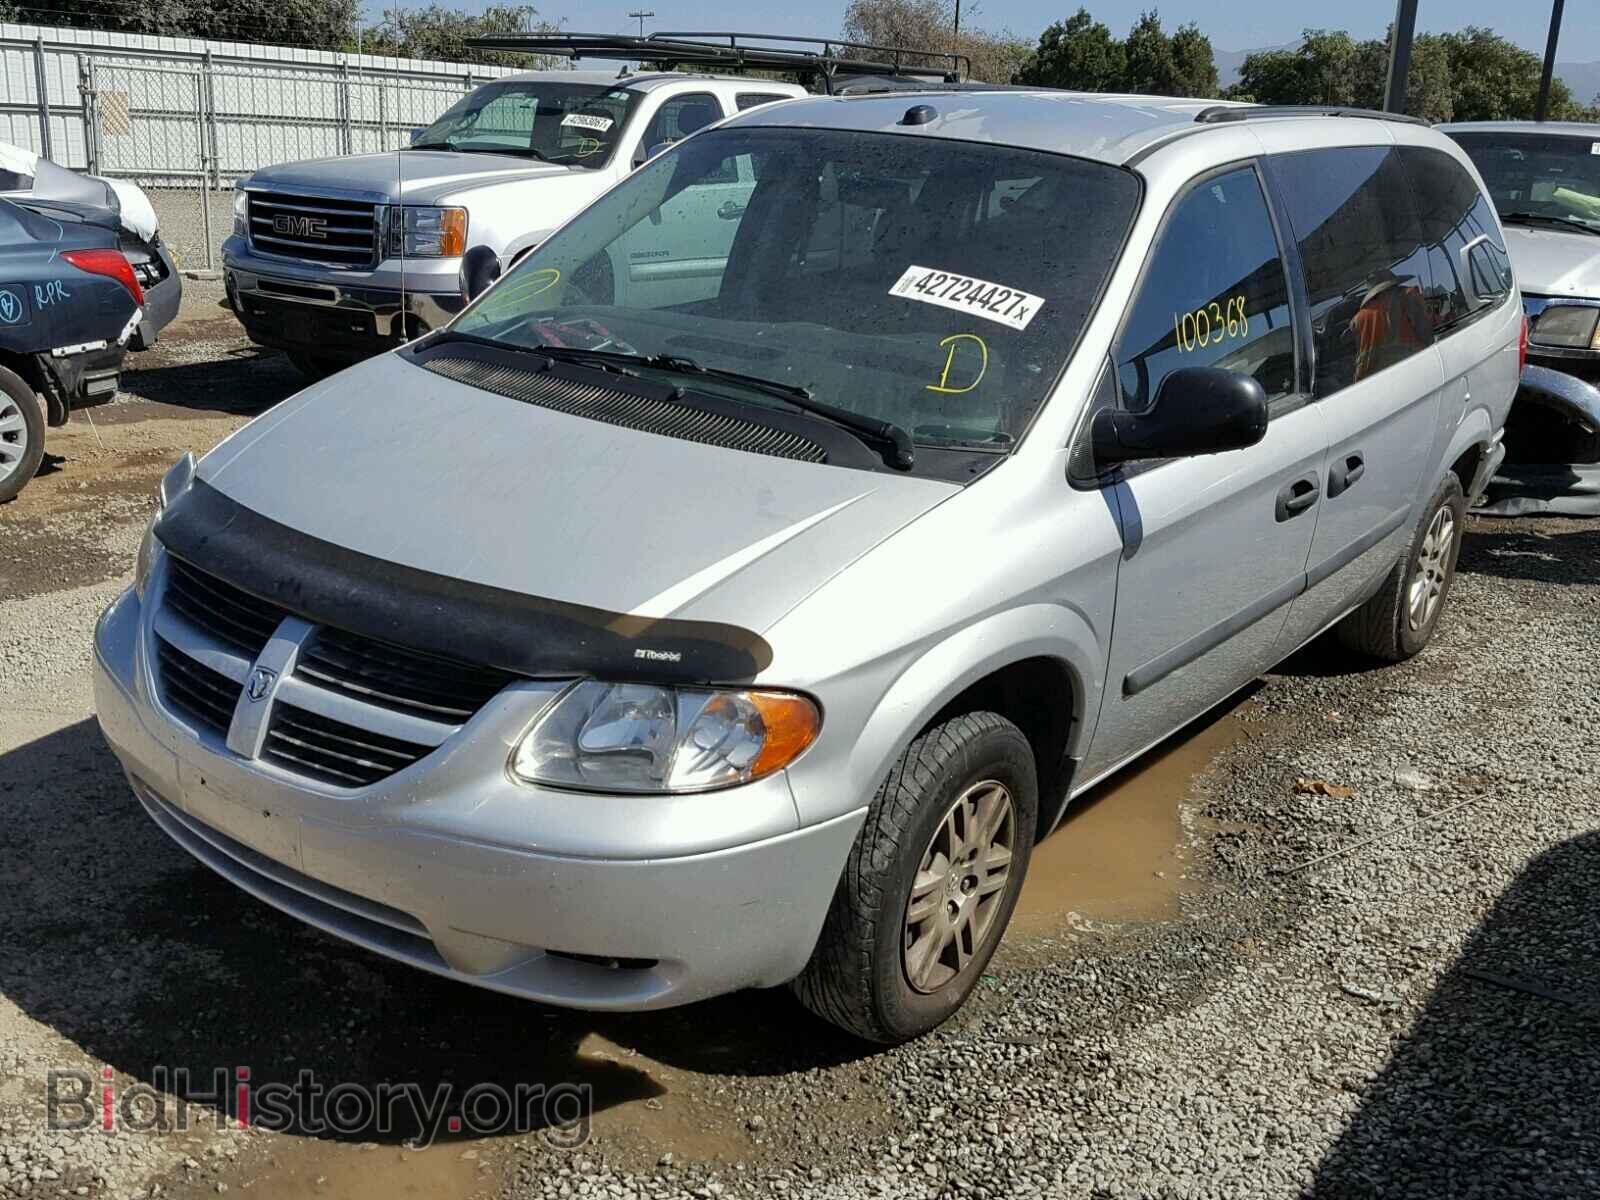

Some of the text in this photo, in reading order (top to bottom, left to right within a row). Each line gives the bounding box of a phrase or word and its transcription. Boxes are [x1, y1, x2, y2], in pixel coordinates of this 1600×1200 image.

[272, 214, 327, 238] GMC
[1174, 295, 1248, 353] 100368
[926, 334, 988, 393] D
